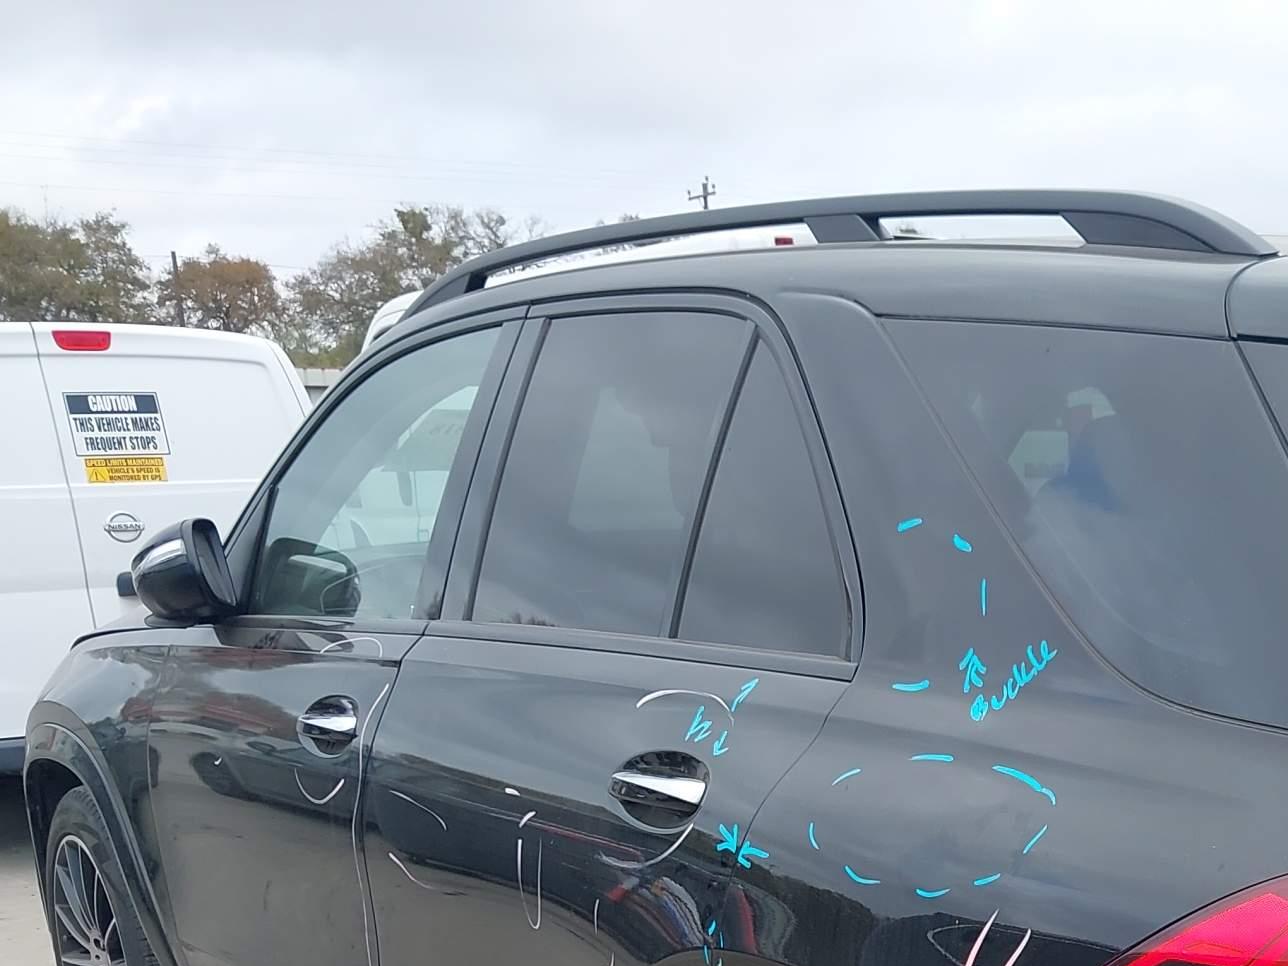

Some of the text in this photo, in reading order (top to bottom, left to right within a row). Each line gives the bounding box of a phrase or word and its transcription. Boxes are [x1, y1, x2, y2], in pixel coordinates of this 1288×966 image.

[87, 395, 138, 412] CAUTION
[73, 416, 161, 433] THIS VEHICLE MAKES
[84, 435, 158, 452] FREQUENT STOPS
